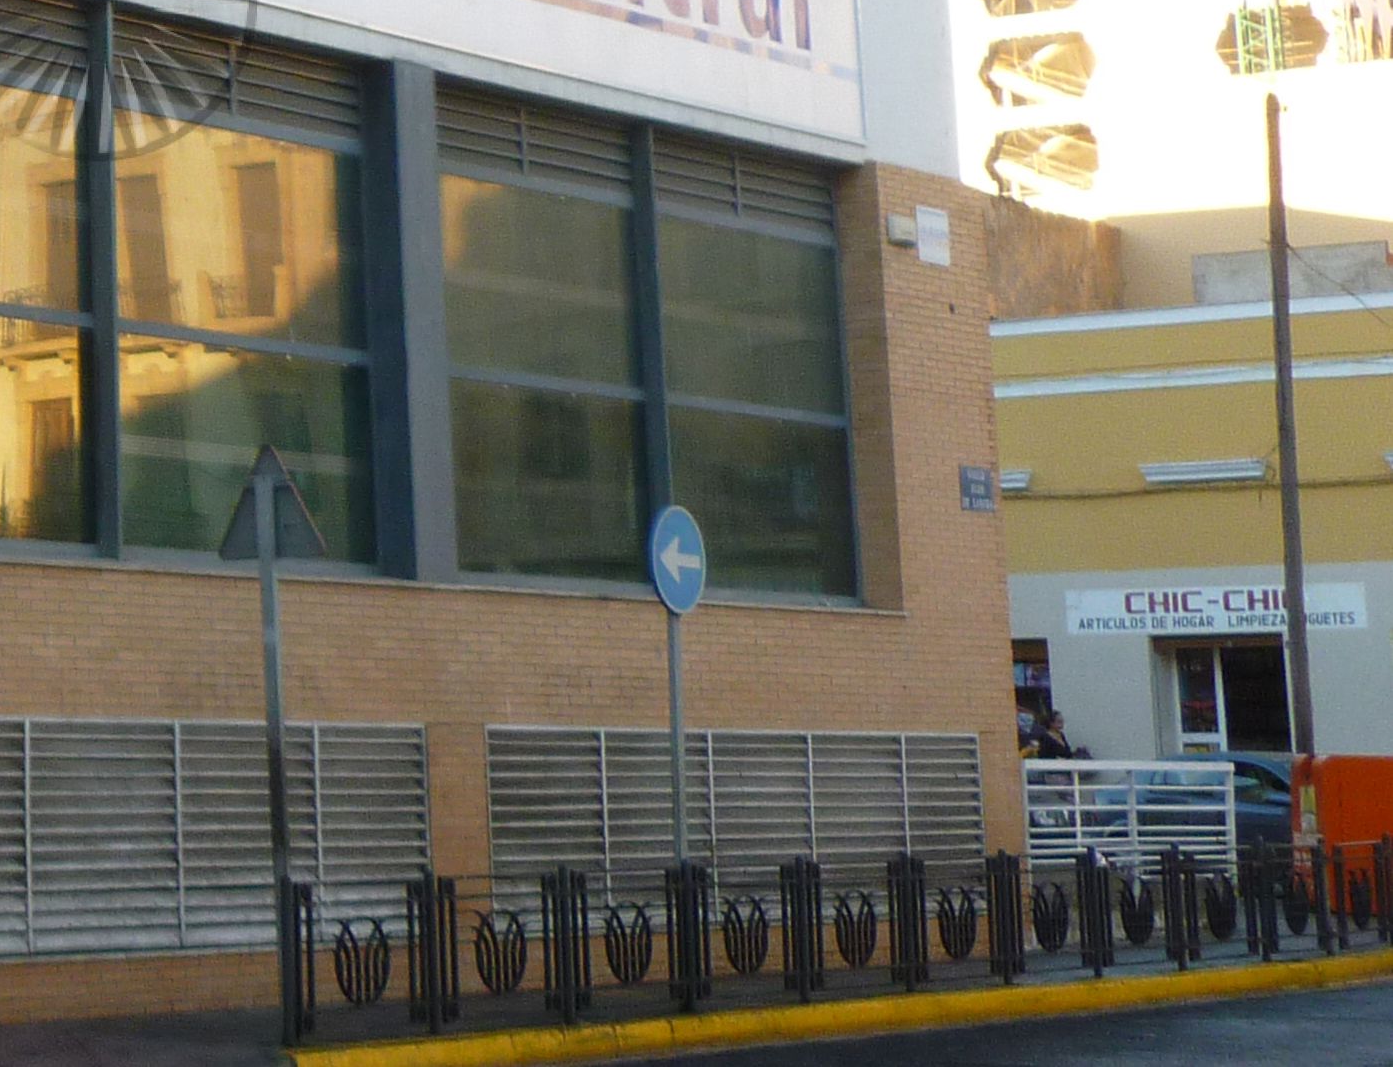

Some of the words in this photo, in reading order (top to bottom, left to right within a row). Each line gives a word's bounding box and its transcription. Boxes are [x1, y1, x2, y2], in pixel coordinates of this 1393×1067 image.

[1078, 616, 1147, 630] ARTICULOS
[1150, 615, 1167, 629] DE
[1172, 615, 1215, 629] HOGAR
[1227, 612, 1287, 627] LIMPIEZA
[1304, 611, 1356, 625] GUETES
